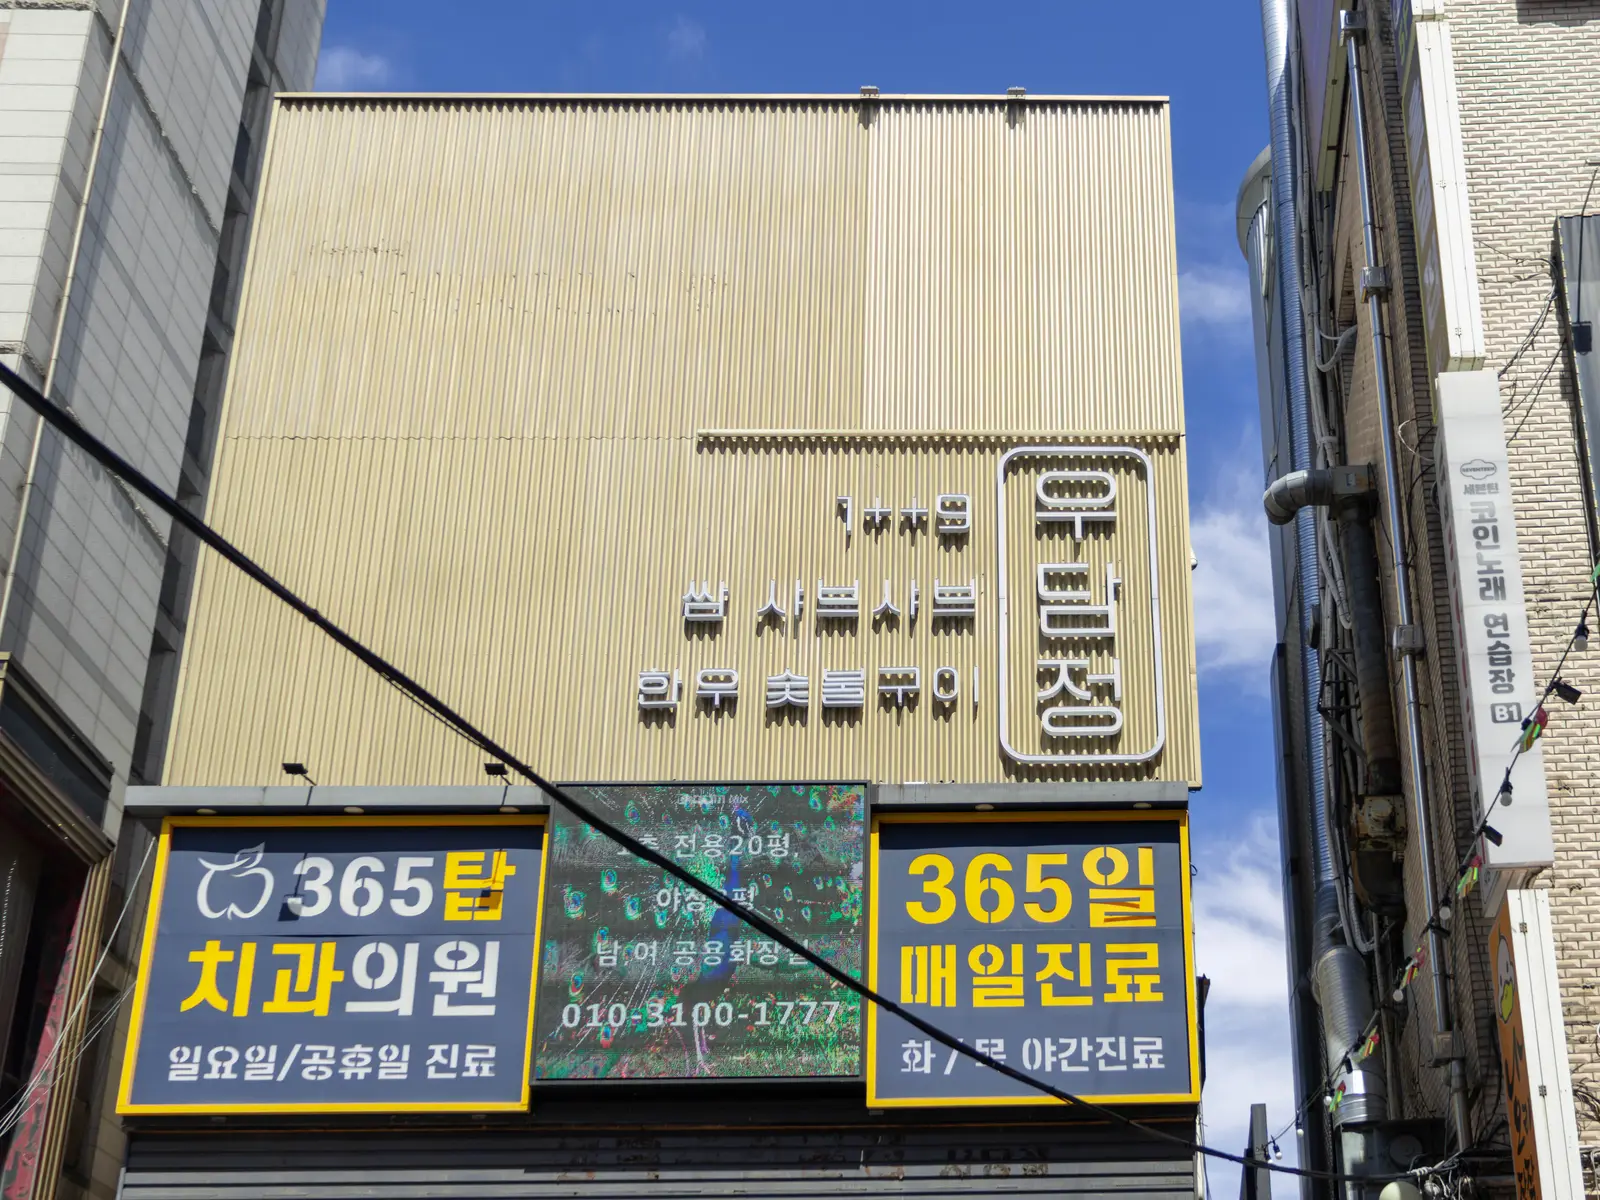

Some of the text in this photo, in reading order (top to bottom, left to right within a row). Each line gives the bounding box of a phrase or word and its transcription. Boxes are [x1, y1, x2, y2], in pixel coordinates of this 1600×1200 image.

[682, 577, 976, 621] 쌈 샤브샤브
[1036, 470, 1123, 737] 우담정
[1470, 501, 1520, 723] 코인노래 연습장 B1
[638, 665, 979, 709] 한우 숯불구이
[291, 851, 517, 921] 365탑
[905, 846, 1157, 928] 365일
[179, 940, 501, 1017] 치과의원
[901, 942, 1164, 1008] 매일진료
[561, 1002, 840, 1028] 010-3100-1777
[168, 1044, 497, 1081] 일요일/공휴일 진료
[1022, 1036, 1166, 1073] 야간진료
